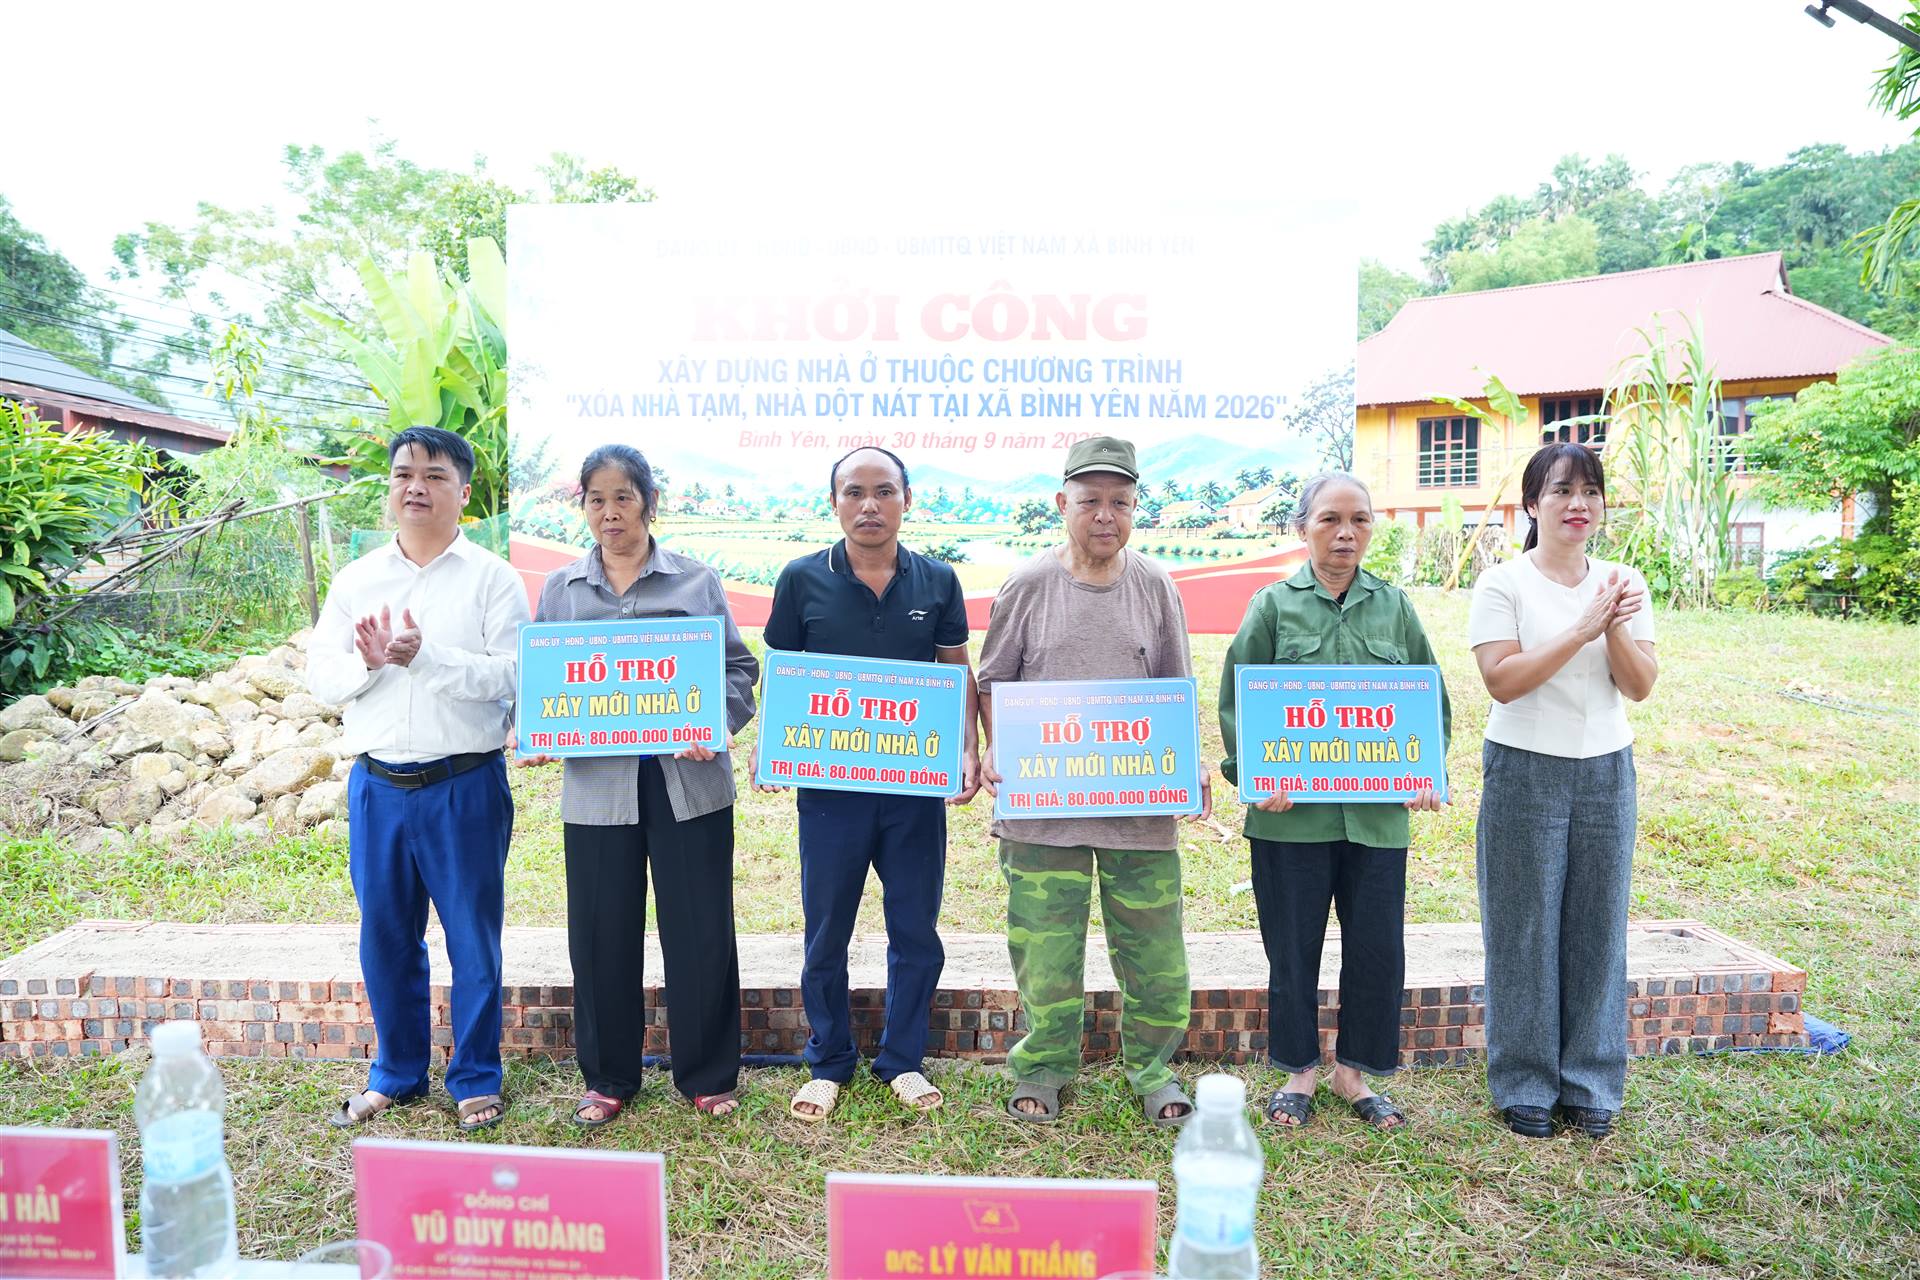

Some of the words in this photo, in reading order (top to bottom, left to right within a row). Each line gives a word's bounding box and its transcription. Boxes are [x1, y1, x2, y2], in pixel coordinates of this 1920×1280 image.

[897, 236, 972, 257] UBMTTQ
[978, 229, 1017, 260] VIỆT
[1022, 235, 1067, 256] NAM
[692, 275, 898, 342] KHỞI
[920, 277, 1148, 343] CÔNG
[658, 354, 707, 383] XÂY
[717, 356, 789, 388] DỰNG
[798, 354, 851, 383] NHÀ
[860, 351, 879, 383] Ở
[887, 353, 975, 389] THUỘC
[984, 356, 1093, 384] CHƯƠNG
[1103, 354, 1182, 384] TRÌNH
[566, 388, 625, 417] "XÓA
[632, 387, 681, 416] NHÀ
[688, 394, 747, 422] TẠM,
[757, 388, 806, 417] NHÀ
[816, 388, 864, 422] DỘT
[873, 387, 921, 417] NÁT
[930, 393, 969, 423] TẠI
[977, 388, 1012, 417] XÃ
[1021, 388, 1081, 417] BÌNH
[1090, 388, 1140, 417] YÊN
[1149, 388, 1206, 418] NĂM
[1215, 394, 1287, 419] 2026"
[791, 430, 831, 452] Yên,
[891, 431, 916, 448] 30
[923, 432, 977, 453] tháng
[984, 432, 996, 449] 9
[1004, 432, 1046, 449] năm
[565, 637, 584, 646] HĐND
[589, 636, 607, 645] UBND
[612, 634, 638, 644] UBMTTQ
[640, 632, 652, 645] VIỆT
[654, 633, 670, 641] NAM
[683, 631, 698, 641] BÌNH
[700, 630, 712, 640] YÊN
[566, 654, 607, 683] HỖ
[617, 656, 676, 683] TRỢ
[811, 669, 829, 678] HĐND
[835, 671, 852, 680] UBND
[858, 673, 882, 683] UBMTTQ
[885, 674, 896, 687] VIỆT
[899, 677, 913, 685] NAM
[926, 677, 941, 687] BÌNH
[943, 678, 955, 688] YÊN
[1064, 696, 1081, 705] UBND
[1087, 695, 1111, 705] UBMTTQ
[1114, 694, 1126, 705] VIỆT
[1128, 695, 1143, 704] NAM
[1155, 693, 1171, 703] BÌNH
[1173, 692, 1184, 703] YÊN
[1283, 681, 1302, 690] HĐND
[1308, 681, 1325, 690] UBND
[1331, 681, 1355, 690] UBMTTQ
[1358, 680, 1370, 691] VIỆT
[1372, 681, 1387, 690] NAM
[1398, 680, 1415, 690] BÌNH
[1417, 680, 1429, 690] YÊN
[541, 692, 583, 718] XÂY
[589, 691, 629, 716] MỚI
[636, 689, 679, 714] NHÀ
[686, 685, 700, 713] Ở
[810, 688, 850, 716] HỖ
[860, 697, 918, 725] TRỢ
[1285, 700, 1326, 728] HỖ
[1335, 704, 1394, 731] TRỢ
[531, 733, 552, 749] TRỊ
[558, 730, 585, 746] GIÁ:
[590, 729, 668, 745] 80.000.000
[783, 723, 825, 749] XÂY
[830, 727, 870, 752] MỚI
[877, 731, 918, 756] NHÀ
[925, 730, 939, 757] Ở
[1041, 714, 1082, 743] HỖ
[1091, 717, 1150, 745] TRỢ
[1019, 753, 1058, 778] XÂY
[1066, 752, 1105, 777] MỚI
[1112, 750, 1155, 775] NHÀ
[1161, 747, 1175, 774] Ở
[1263, 737, 1303, 762] XÂY
[1310, 737, 1350, 762] MỚI
[1356, 737, 1400, 762] NHÀ
[1406, 735, 1420, 762] Ở
[771, 761, 792, 779] TRỊ
[797, 761, 825, 777] GIÁ:
[830, 765, 905, 783] 80.000.000
[1254, 777, 1275, 793] TRỊ
[1280, 775, 1307, 791] GIÁ:
[1312, 778, 1389, 791] 80.000.000
[1009, 793, 1031, 810] TRỊ
[1036, 790, 1063, 807] GIÁ:
[1068, 791, 1144, 805] 80.000.000
[15, 1184, 60, 1224] HẢI
[464, 1189, 514, 1210] ĐỒNG
[518, 1194, 549, 1212] CHÍ
[412, 1209, 447, 1244] VŨ
[454, 1216, 505, 1247] DUY
[512, 1215, 605, 1252] HOÀNG
[929, 1241, 958, 1275] LÝ
[963, 1243, 1012, 1276] VĂN
[1018, 1240, 1096, 1278] THẮNG
